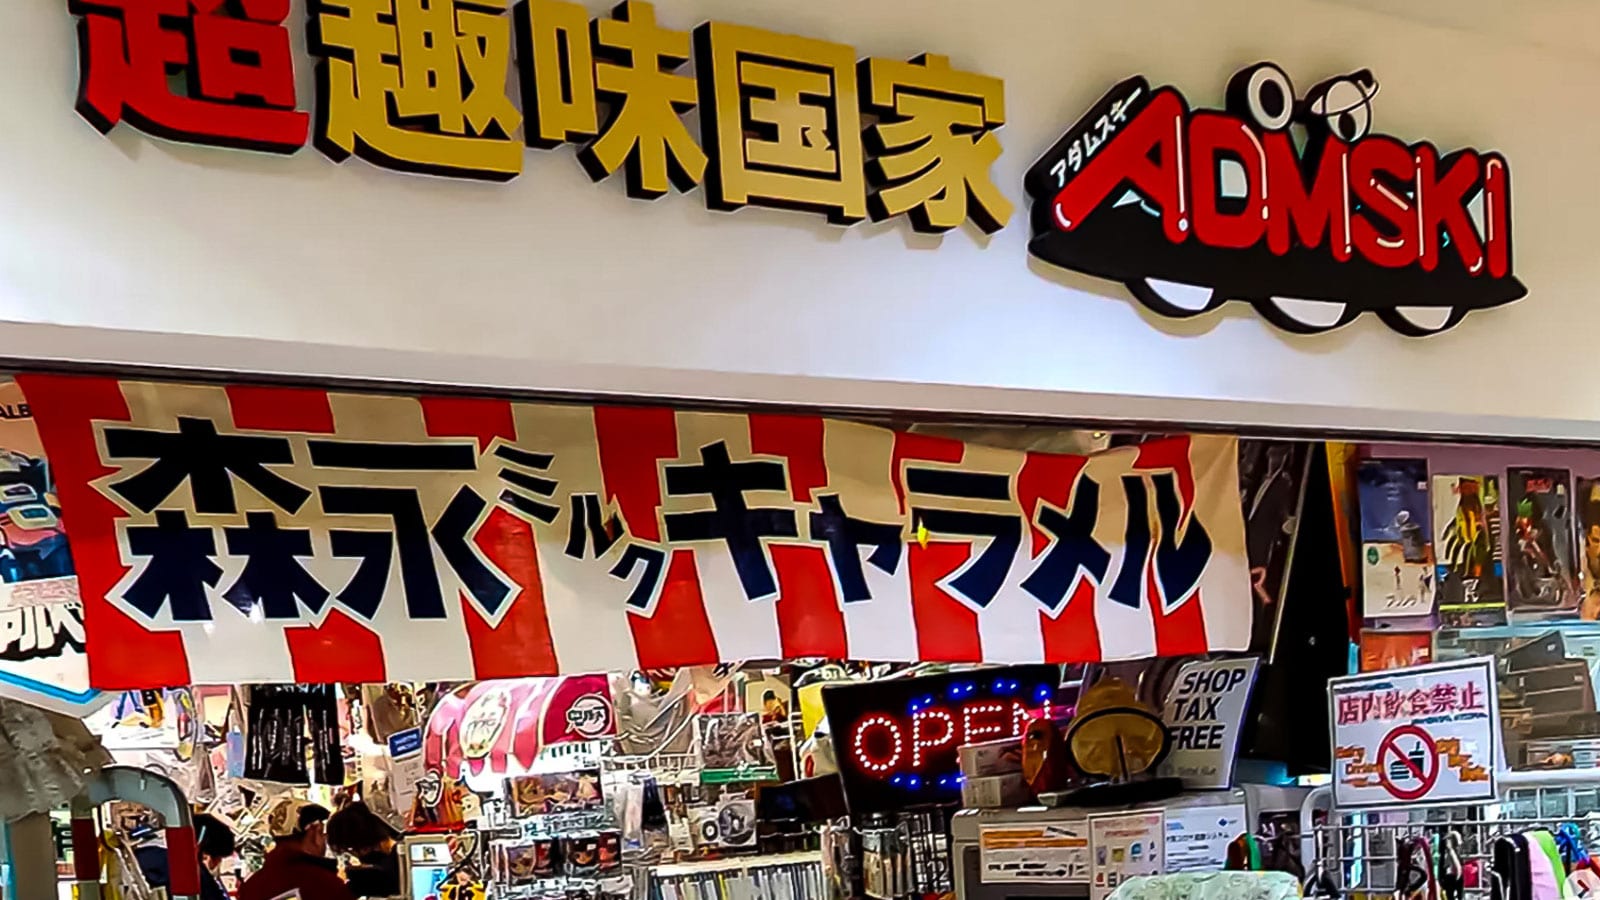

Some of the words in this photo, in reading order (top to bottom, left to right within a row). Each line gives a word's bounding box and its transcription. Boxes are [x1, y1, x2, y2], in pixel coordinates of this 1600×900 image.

[1049, 86, 1142, 188] アダムスキー
[1179, 668, 1247, 695] SHOP
[1173, 696, 1222, 721] TAX
[1337, 681, 1484, 726] 店内飲食禁止
[1168, 724, 1226, 750] FREE
